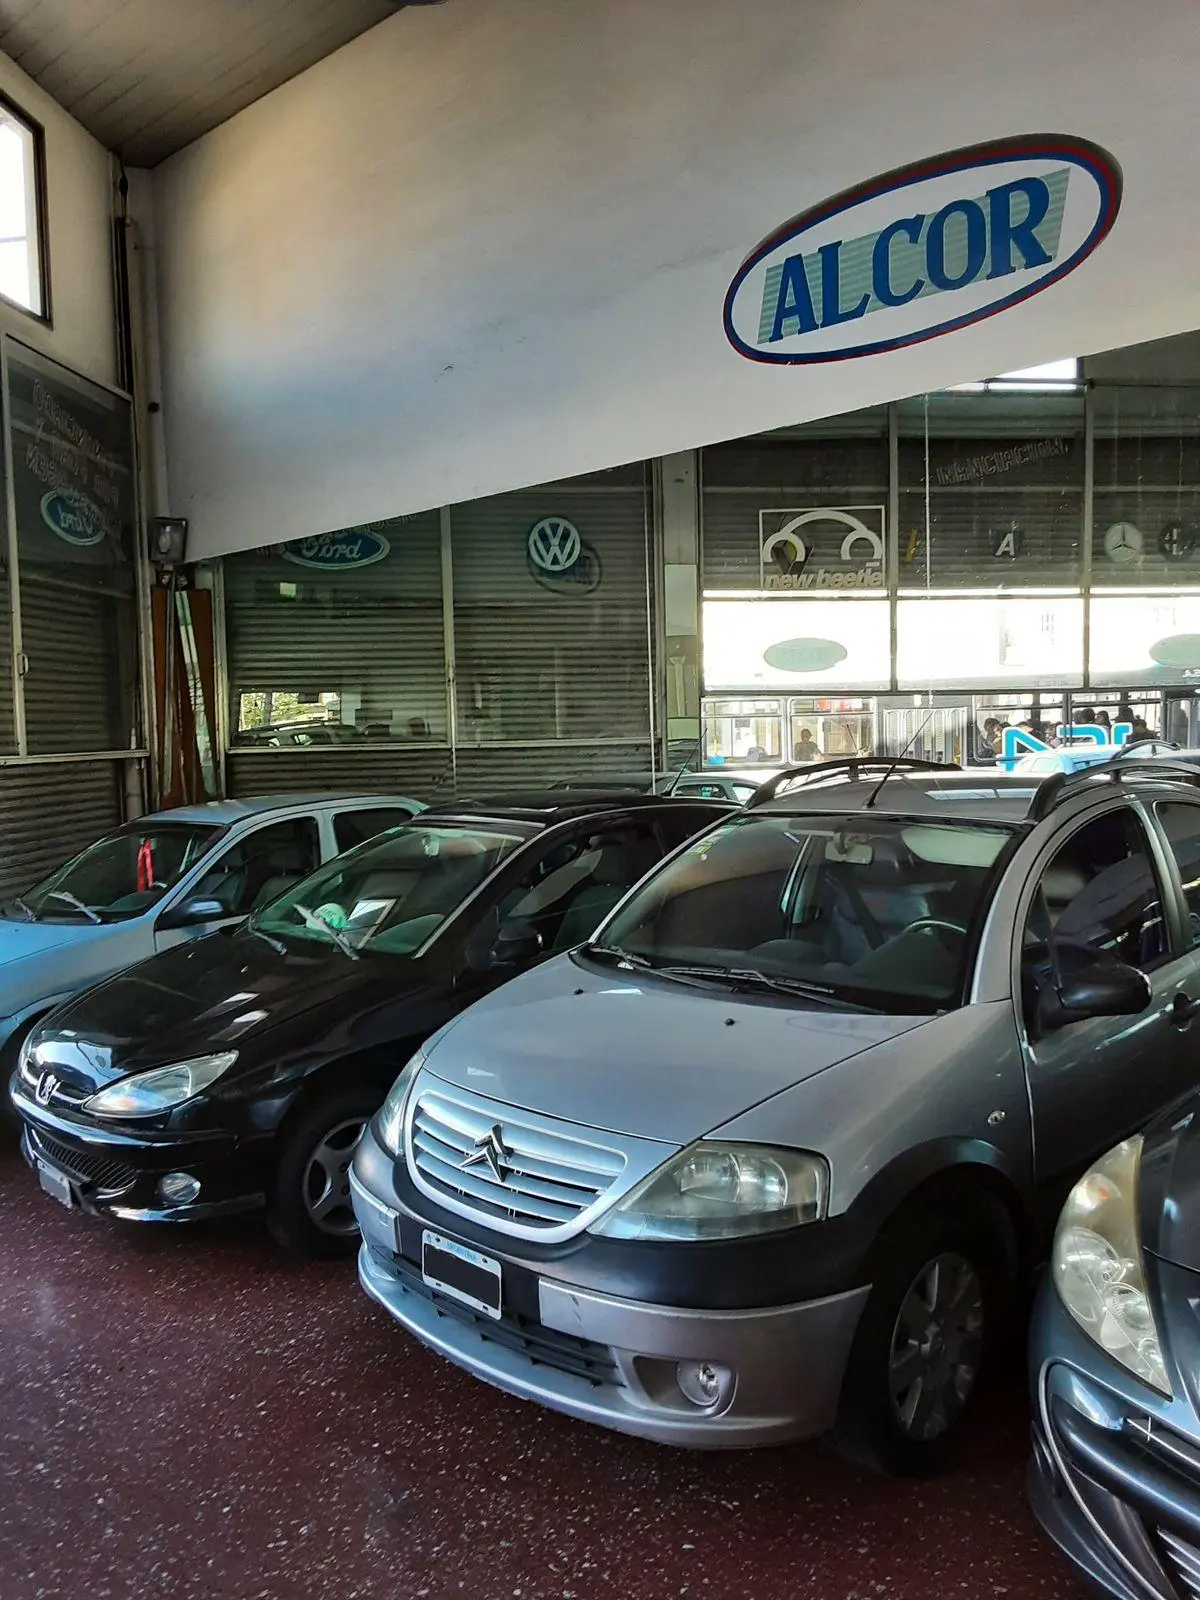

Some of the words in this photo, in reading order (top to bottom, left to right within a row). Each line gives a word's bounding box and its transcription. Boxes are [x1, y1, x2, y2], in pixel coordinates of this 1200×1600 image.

[768, 176, 1053, 343] ALCOR
[764, 574, 814, 590] new
[816, 568, 883, 588] beetle
